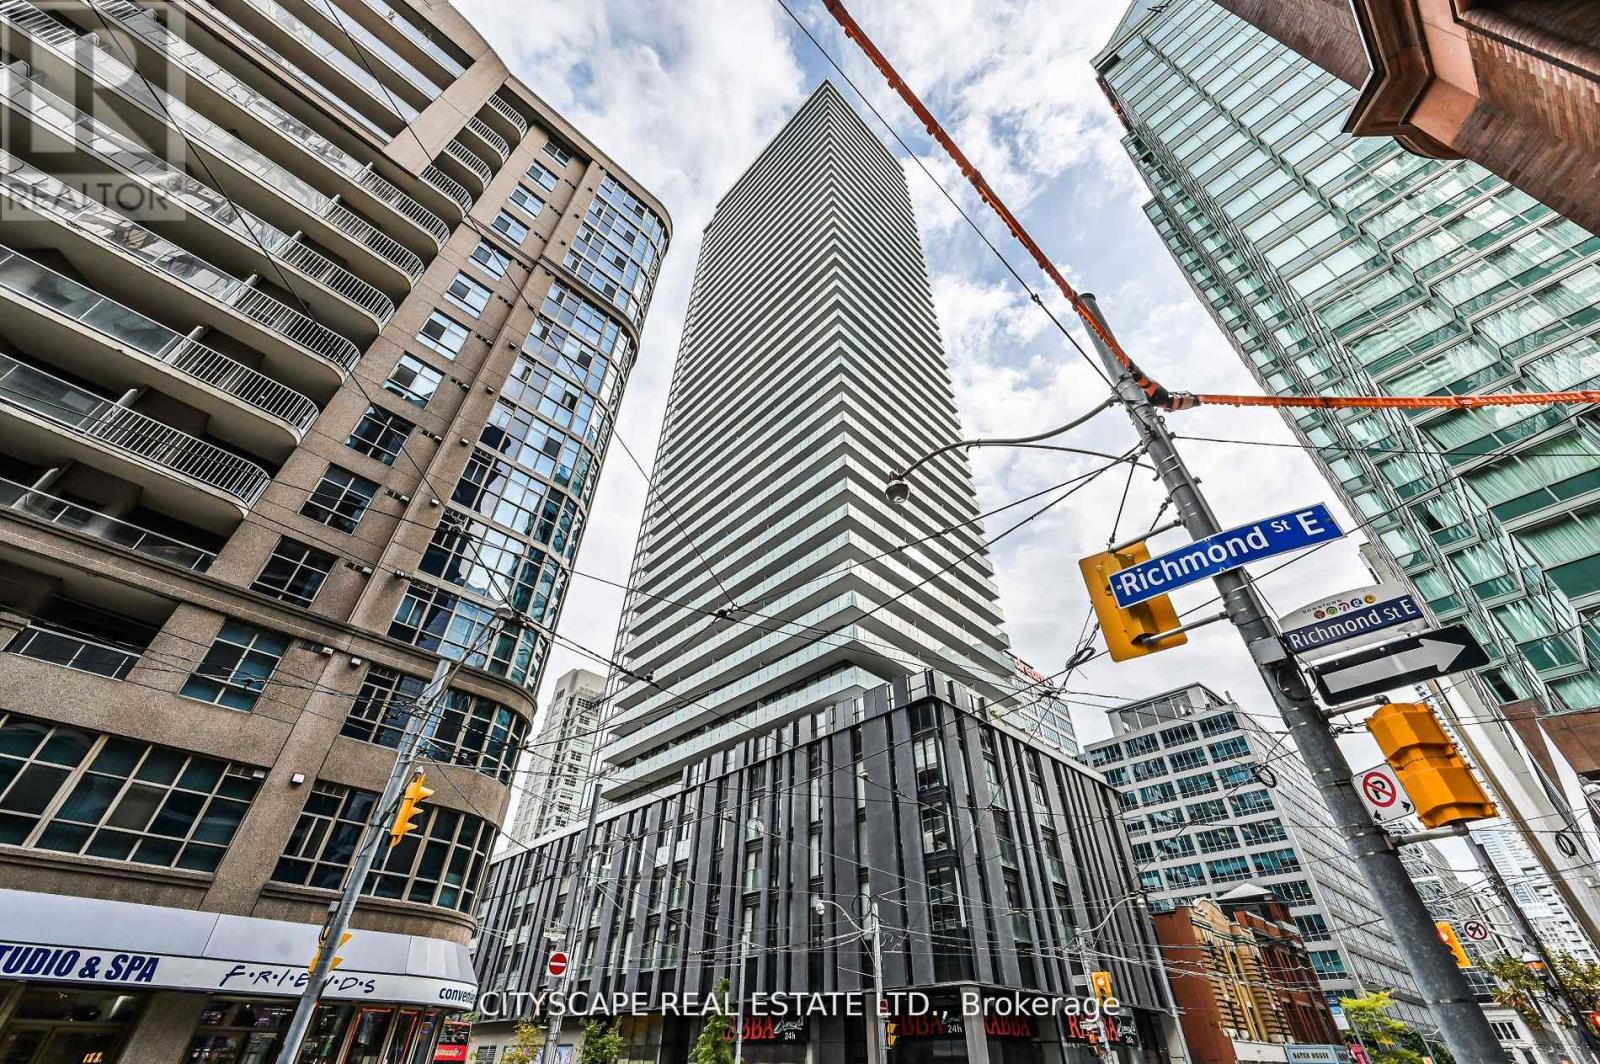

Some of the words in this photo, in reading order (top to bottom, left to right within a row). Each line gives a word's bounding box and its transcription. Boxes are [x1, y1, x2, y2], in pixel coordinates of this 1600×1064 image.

[1120, 526, 1269, 596] Richmond
[1271, 519, 1291, 533] St
[1296, 511, 1326, 536] E
[1289, 609, 1382, 649] Richmond
[1384, 608, 1402, 621] St
[1400, 598, 1416, 615] E
[78, 956, 101, 979] &
[105, 954, 160, 982] SPA
[784, 1031, 796, 1040] 24h
[947, 1024, 963, 1034] 24h
[984, 1012, 1031, 1037] ABBA
